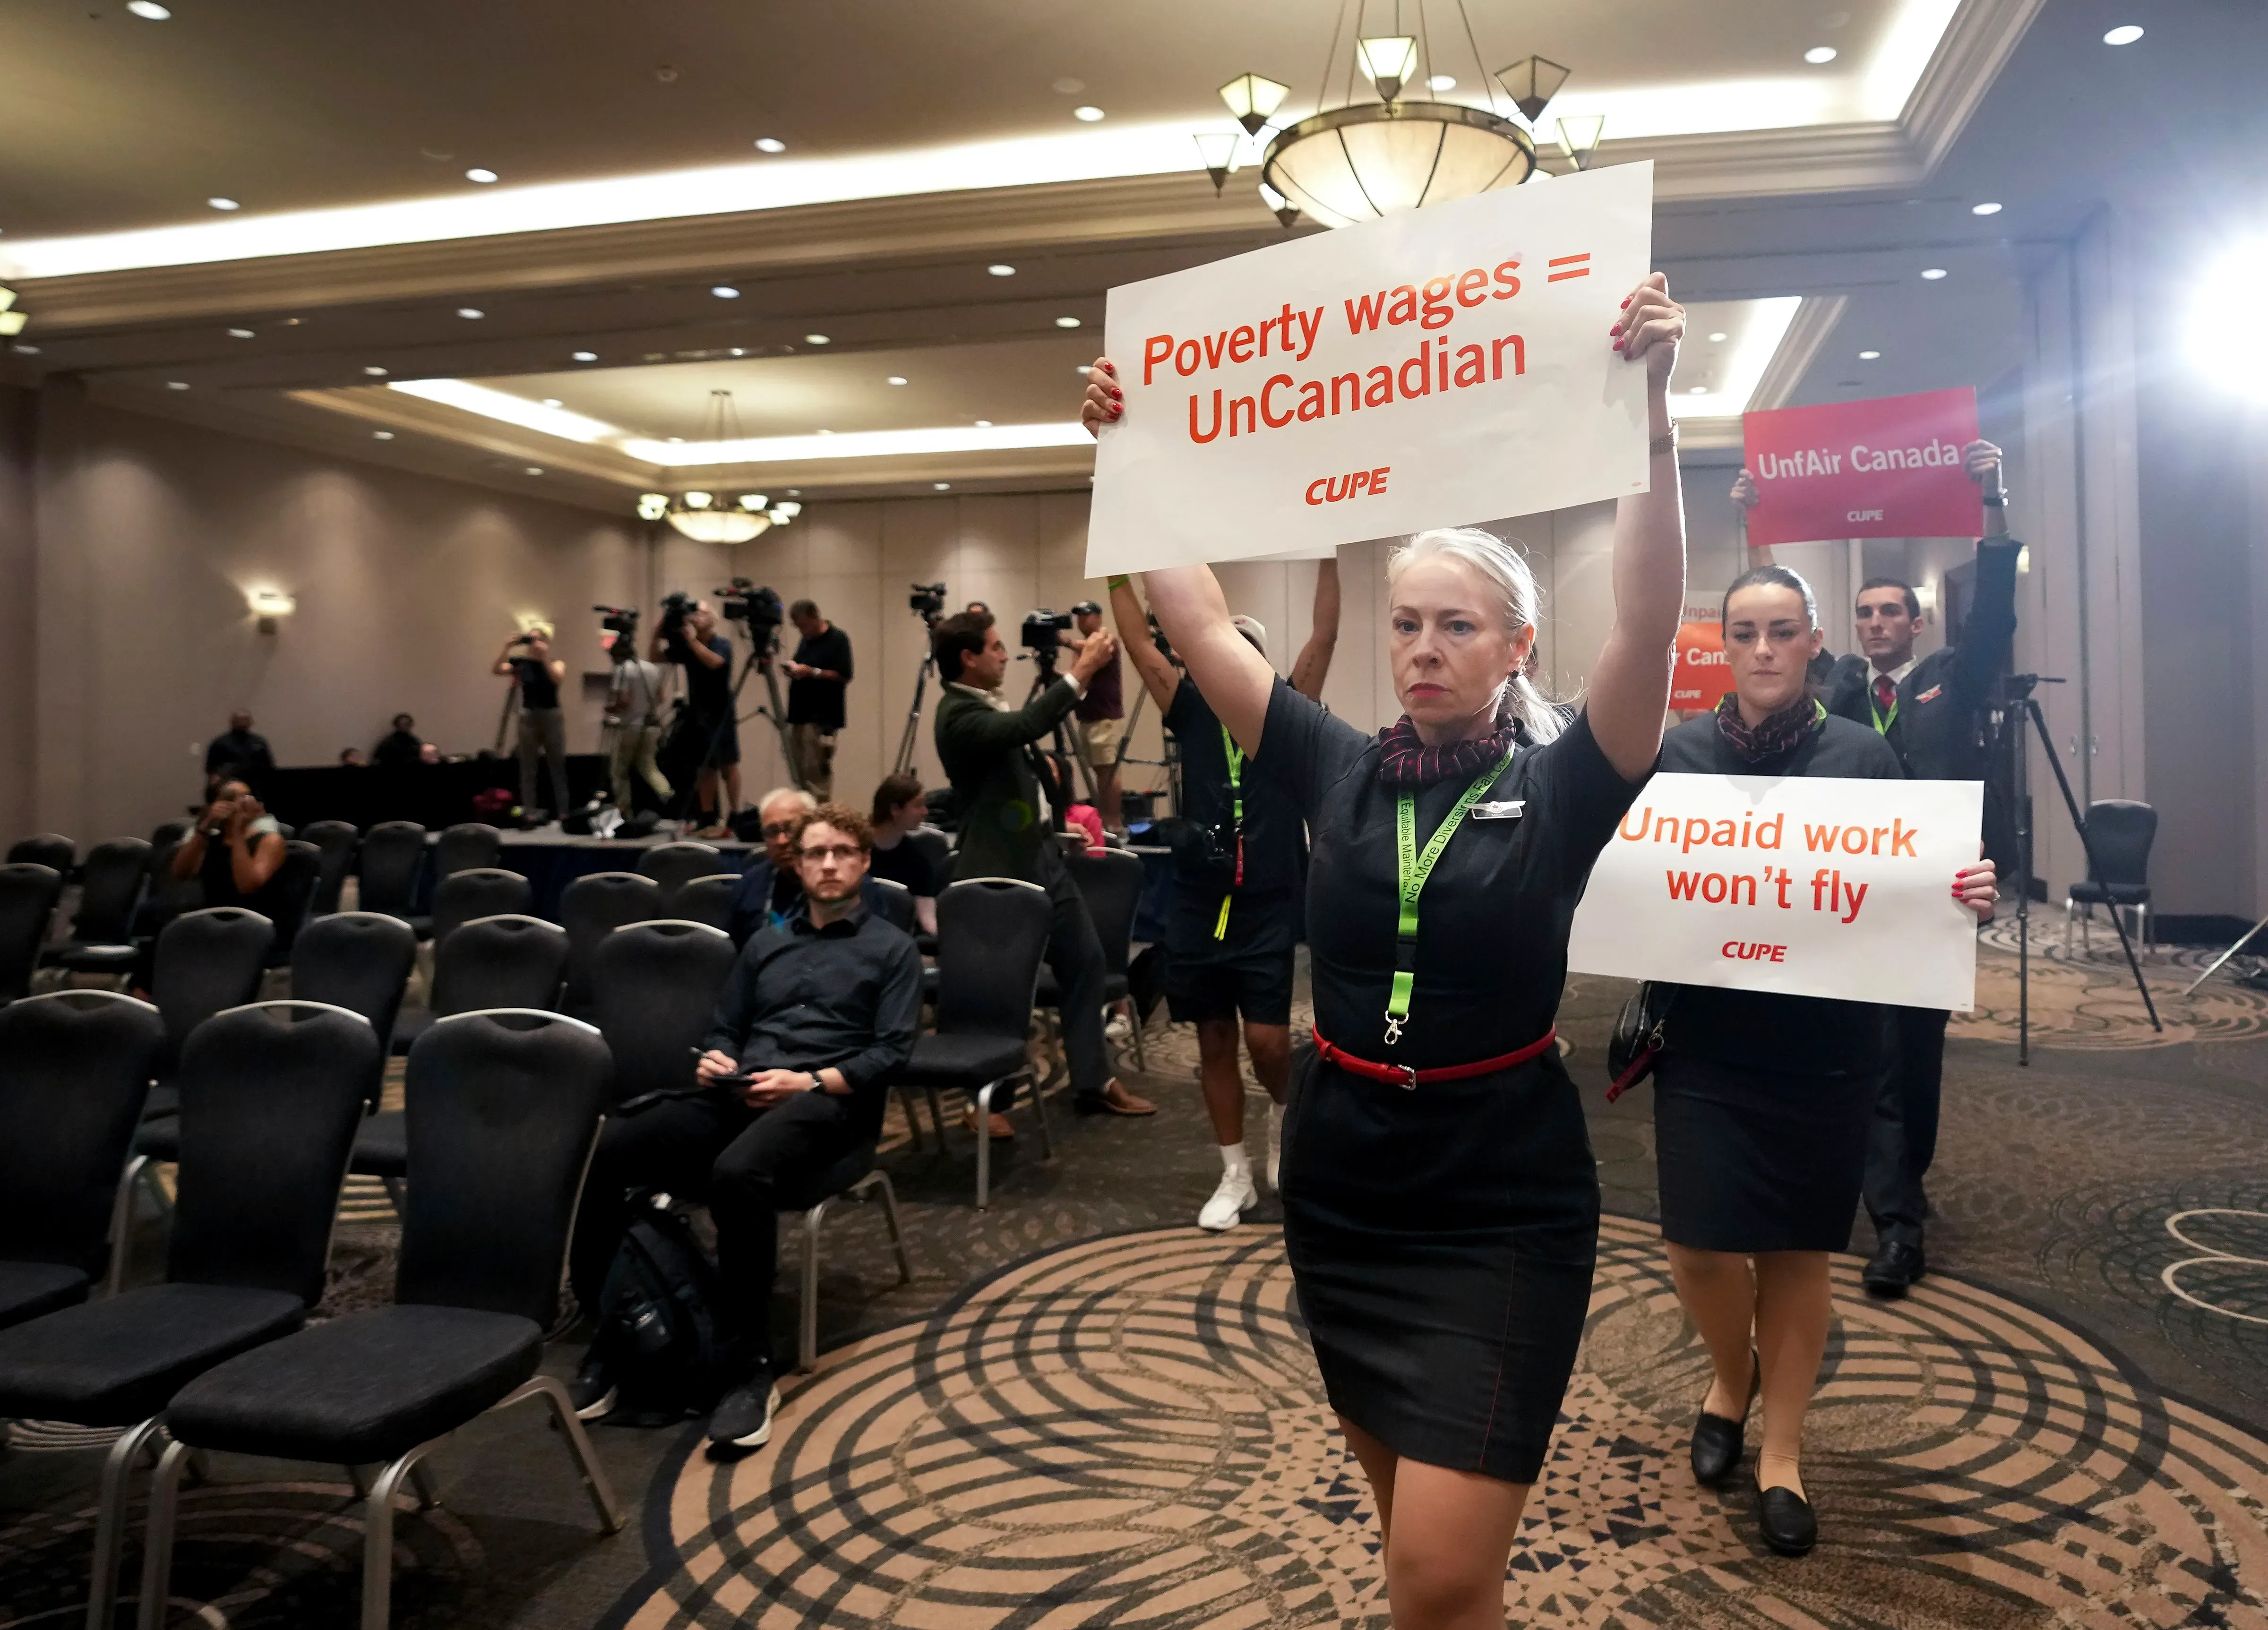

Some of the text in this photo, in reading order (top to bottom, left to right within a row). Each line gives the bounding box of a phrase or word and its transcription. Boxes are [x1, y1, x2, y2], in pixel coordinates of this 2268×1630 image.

[1143, 253, 1591, 386] Poverty wages =
[1189, 334, 1526, 445] UnCanadian
[1759, 438, 1959, 480] UnfAir Canada
[1305, 466, 1391, 506] CUPE
[1847, 509, 1884, 523] CUPE
[1399, 802, 1413, 841] Équitable
[1619, 806, 1917, 857] Unpaid work
[1404, 883, 1420, 904] No
[1414, 846, 1440, 879] More
[1667, 865, 1868, 924] won't fly
[1721, 941, 1787, 963] CUPE
